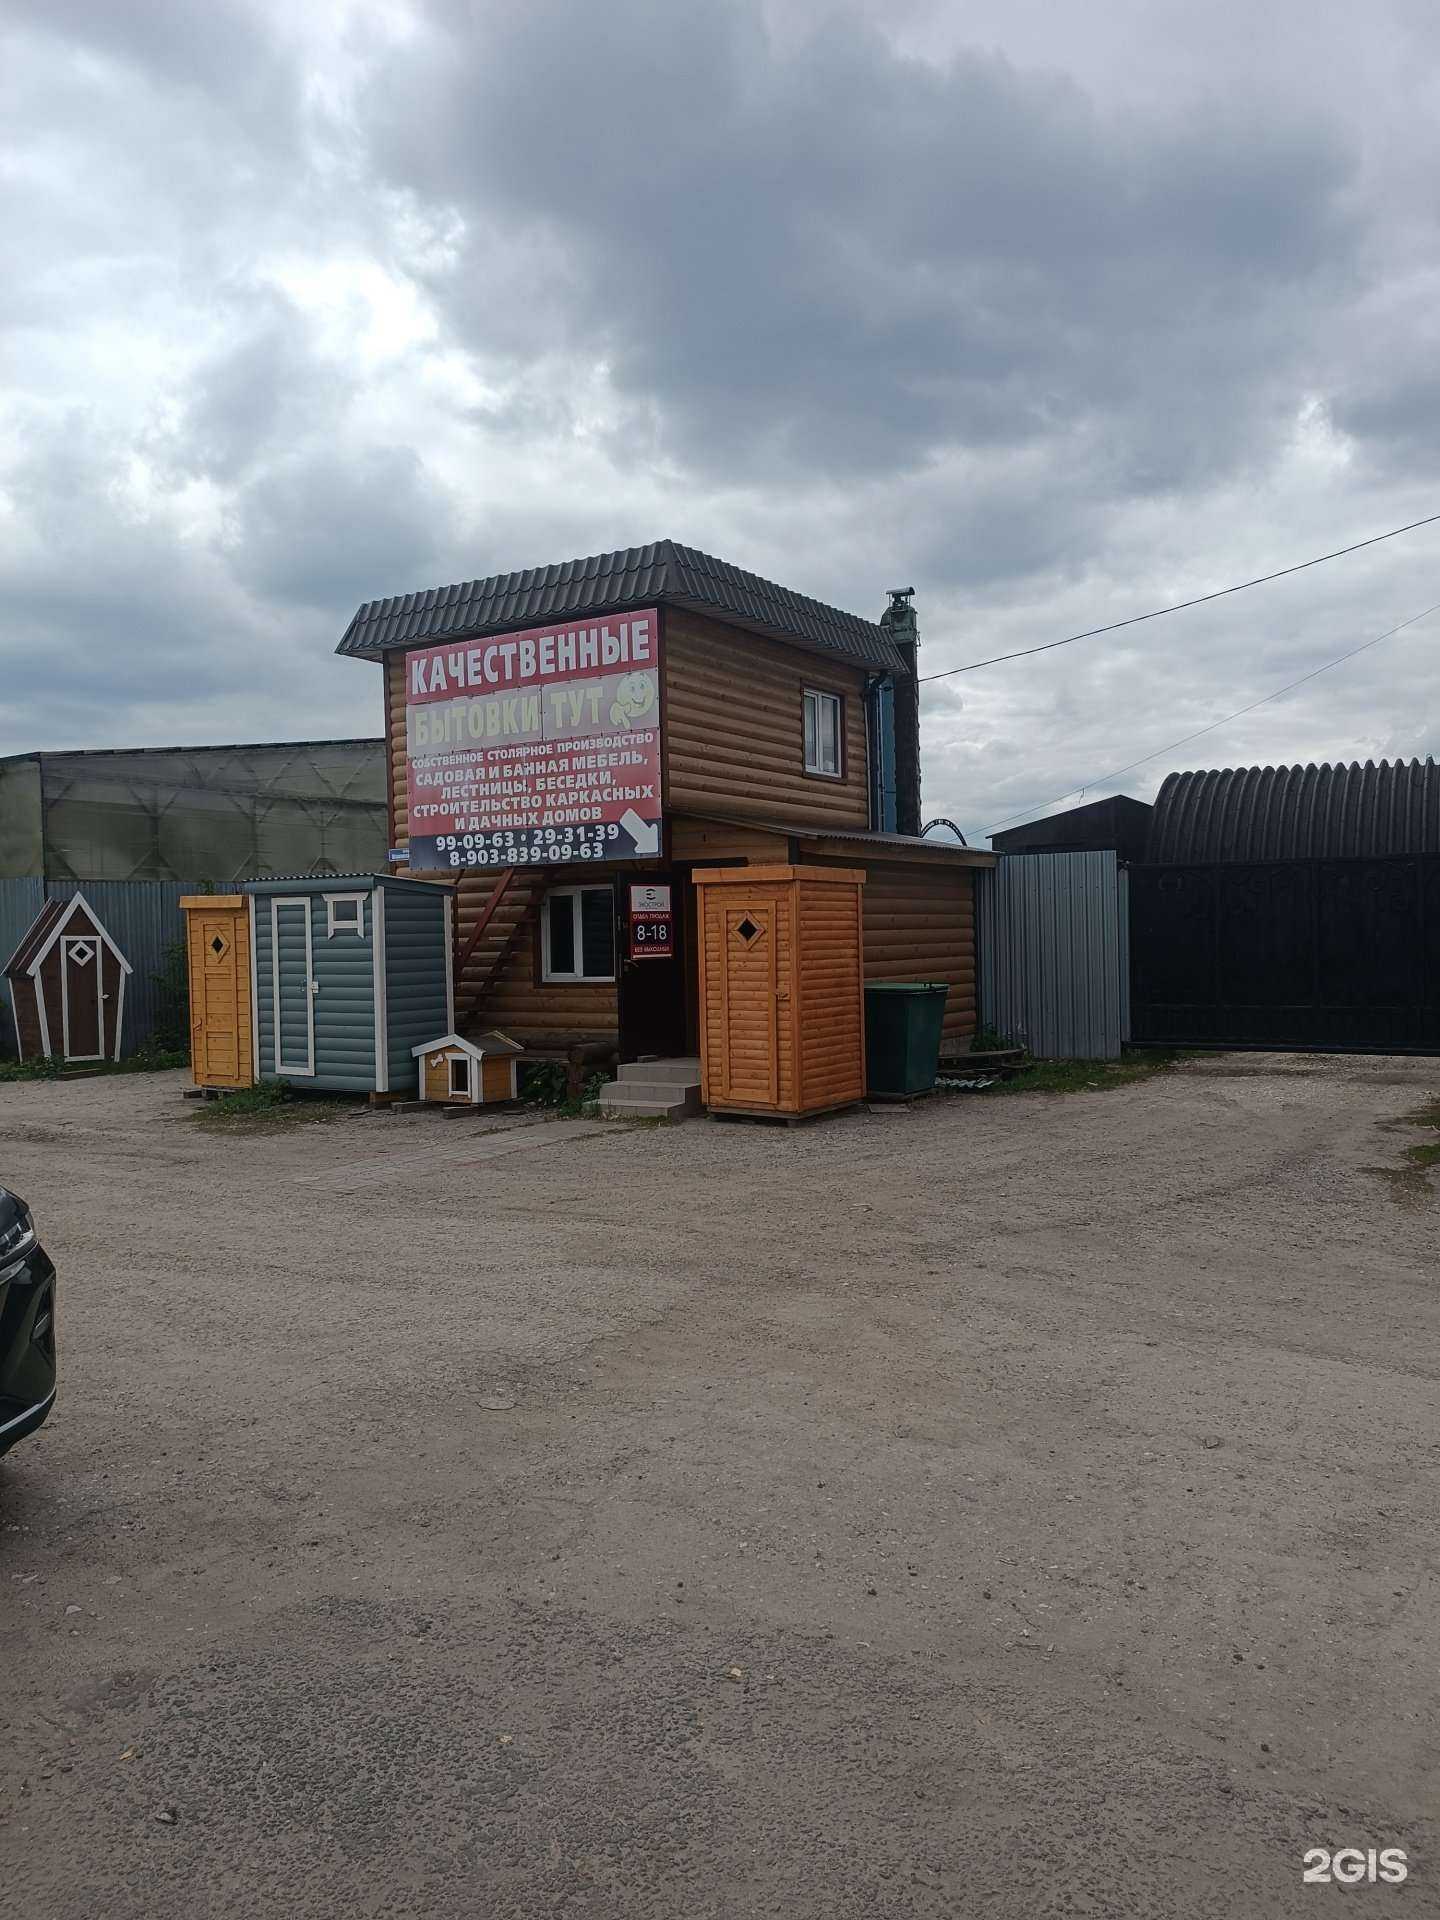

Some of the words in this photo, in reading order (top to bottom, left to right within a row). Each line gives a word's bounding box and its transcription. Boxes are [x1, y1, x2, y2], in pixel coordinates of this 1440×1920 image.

[411, 619, 650, 695] КАЧЕСТВЕННЫЕ
[415, 695, 541, 746] БЫТОВКИ
[551, 686, 604, 729] ТУТ
[412, 752, 484, 769] СОБСТВЕННОЕ
[487, 744, 553, 761] СТОЛЯРНОЕ
[557, 732, 654, 753] ПРОИЗВОДСТВО
[416, 767, 485, 786] САДОВАЯ
[488, 766, 500, 779] И
[503, 759, 569, 778] БАННАЯ
[572, 750, 649, 770] МЕБЕЛЬ,
[441, 779, 532, 799] ЛЕСТНИЦЫ,
[536, 771, 616, 791] БЕСЕДКИ,
[413, 794, 543, 818] СТРОИТЕЛЬСТВО
[545, 784, 654, 807] КАРКАСНЫХ
[454, 817, 465, 830] И
[468, 811, 538, 831] ДАЧНЫХ
[542, 806, 602, 826] ДОМОВ
[436, 831, 515, 852] 99-09-63
[533, 823, 619, 845] 29-31-39
[449, 841, 604, 866] 8-903-839-09-63
[637, 924, 667, 941] 8-18
